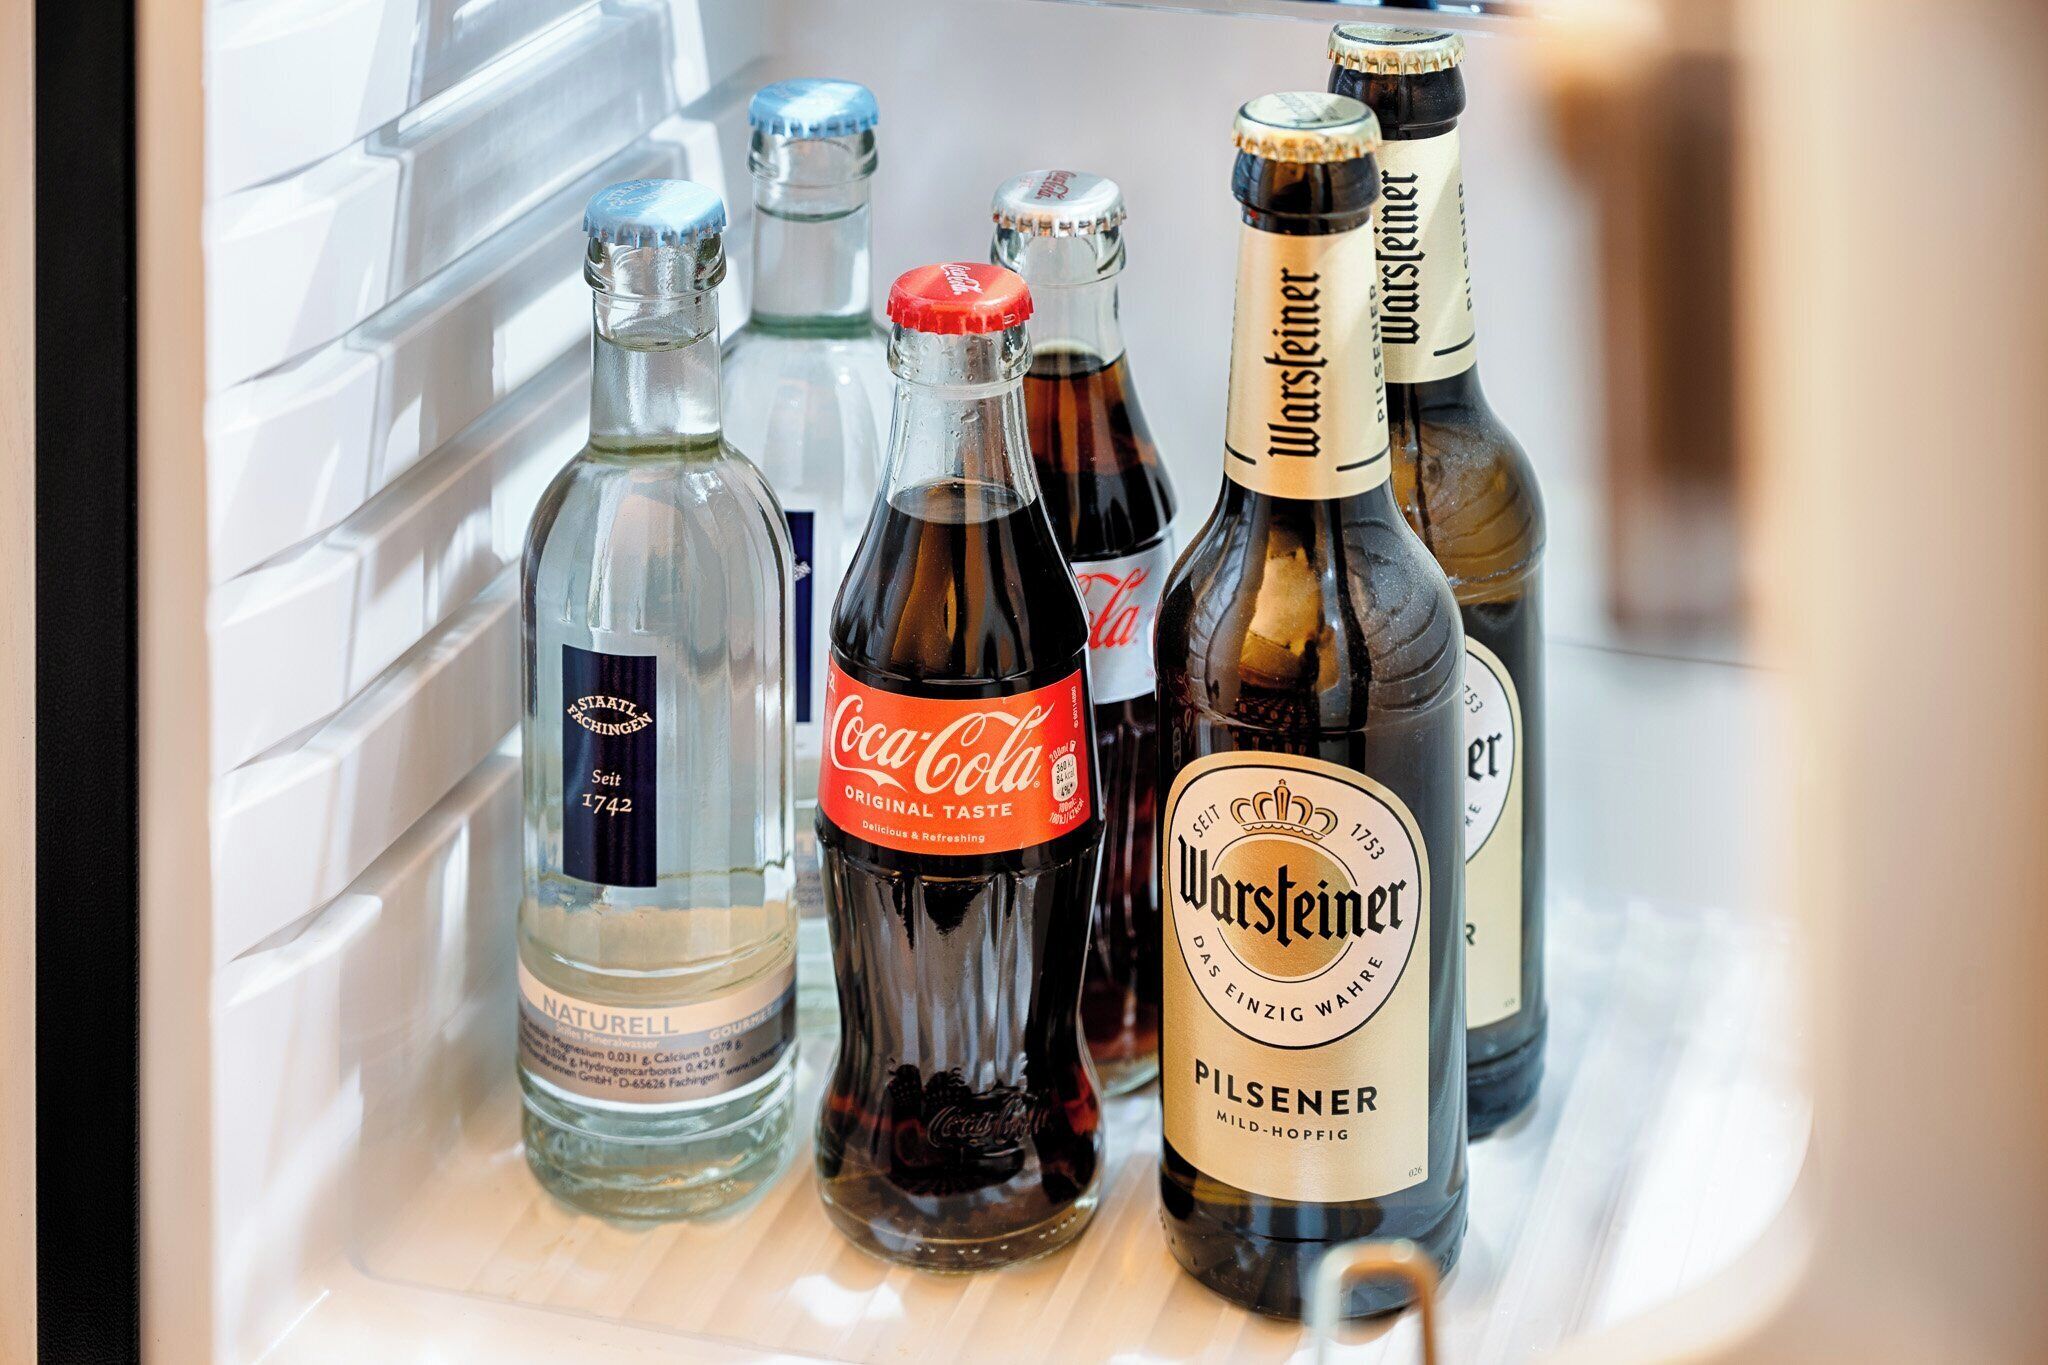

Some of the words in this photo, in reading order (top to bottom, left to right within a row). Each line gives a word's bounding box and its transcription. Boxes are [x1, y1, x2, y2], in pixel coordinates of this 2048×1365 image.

[1374, 169, 1426, 345] Warsteiner
[1264, 267, 1328, 459] Warsteiner
[1369, 284, 1385, 424] PILSENER
[566, 704, 653, 736] FACHINGEN
[830, 694, 1055, 796] Coca-Cola
[591, 769, 622, 787] Seit
[582, 793, 632, 816] 1742
[845, 784, 933, 818] ORIGINAL
[943, 802, 1013, 819] TASTE
[862, 820, 908, 838] Delicious
[911, 832, 919, 840] &
[922, 832, 985, 844] Refreshing
[1193, 803, 1221, 839] SEIT
[1350, 823, 1385, 861] 1753
[1178, 834, 1408, 948] Warsteiner
[1193, 935, 1219, 978] DAS
[1225, 983, 1304, 1023] EINZIG
[1315, 956, 1383, 1017] WAHRE
[544, 994, 679, 1035] NATURELL
[653, 1050, 700, 1064] Calcium
[579, 1071, 612, 1086] GmbH
[1195, 1058, 1378, 1116] PILSENER
[1216, 1110, 1349, 1141] MILD-HOPFIG
[1408, 1165, 1423, 1179] 026
